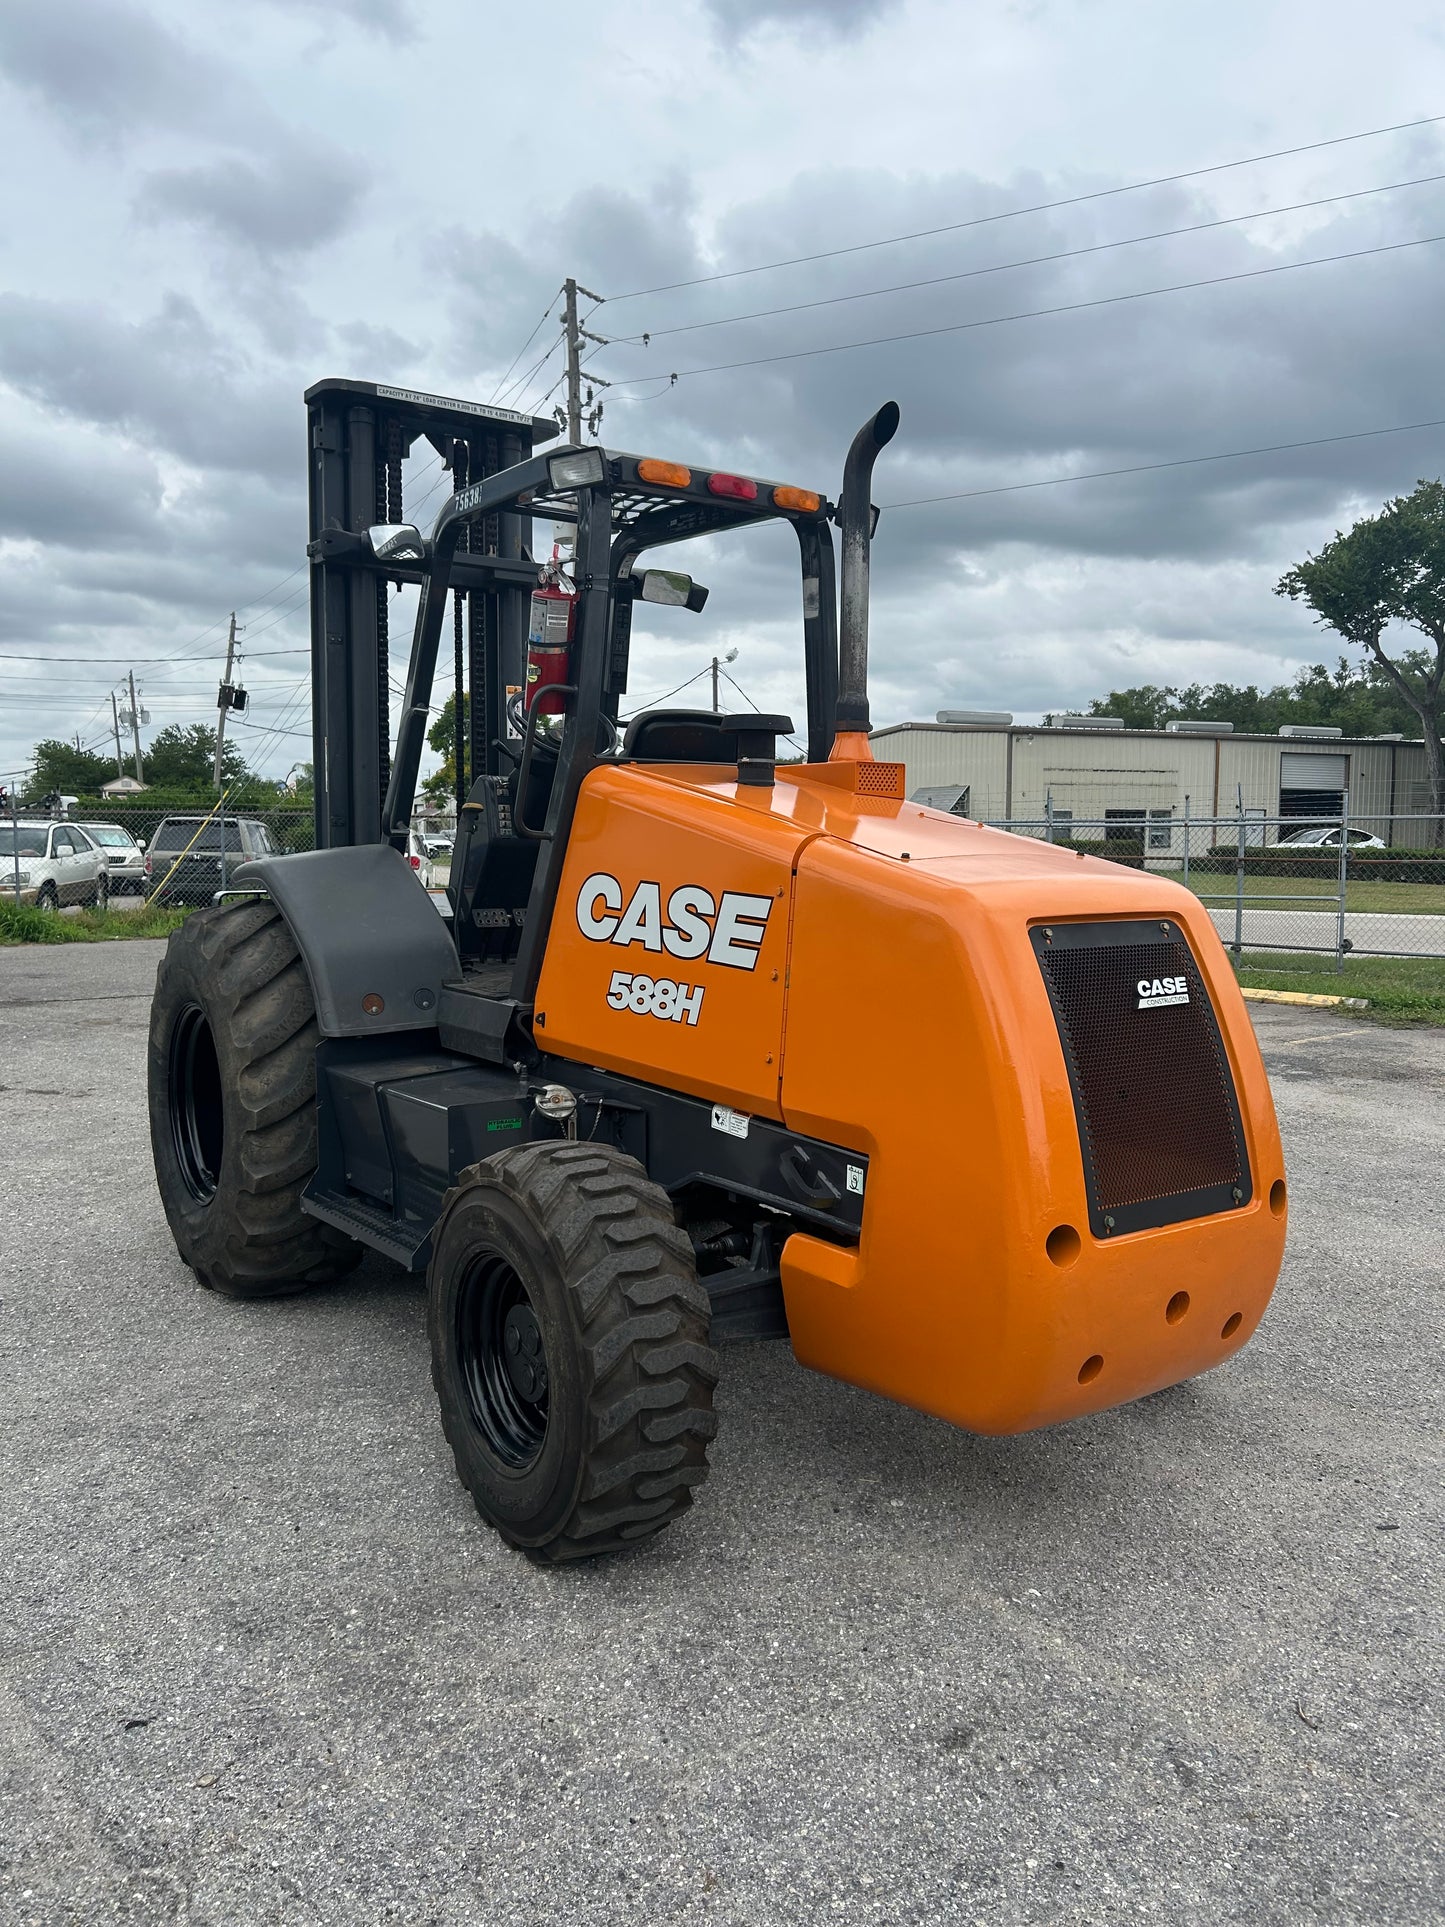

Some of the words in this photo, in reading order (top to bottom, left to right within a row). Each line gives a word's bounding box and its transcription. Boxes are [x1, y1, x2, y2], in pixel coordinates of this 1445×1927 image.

[379, 388, 403, 397] CAPACITY
[422, 396, 436, 404] LOAD
[437, 399, 456, 408] CENTER
[576, 871, 774, 972] CASE
[1137, 976, 1188, 997] CASE
[606, 970, 705, 1027] 588H
[1146, 996, 1188, 1006] CONSTRUCTION
